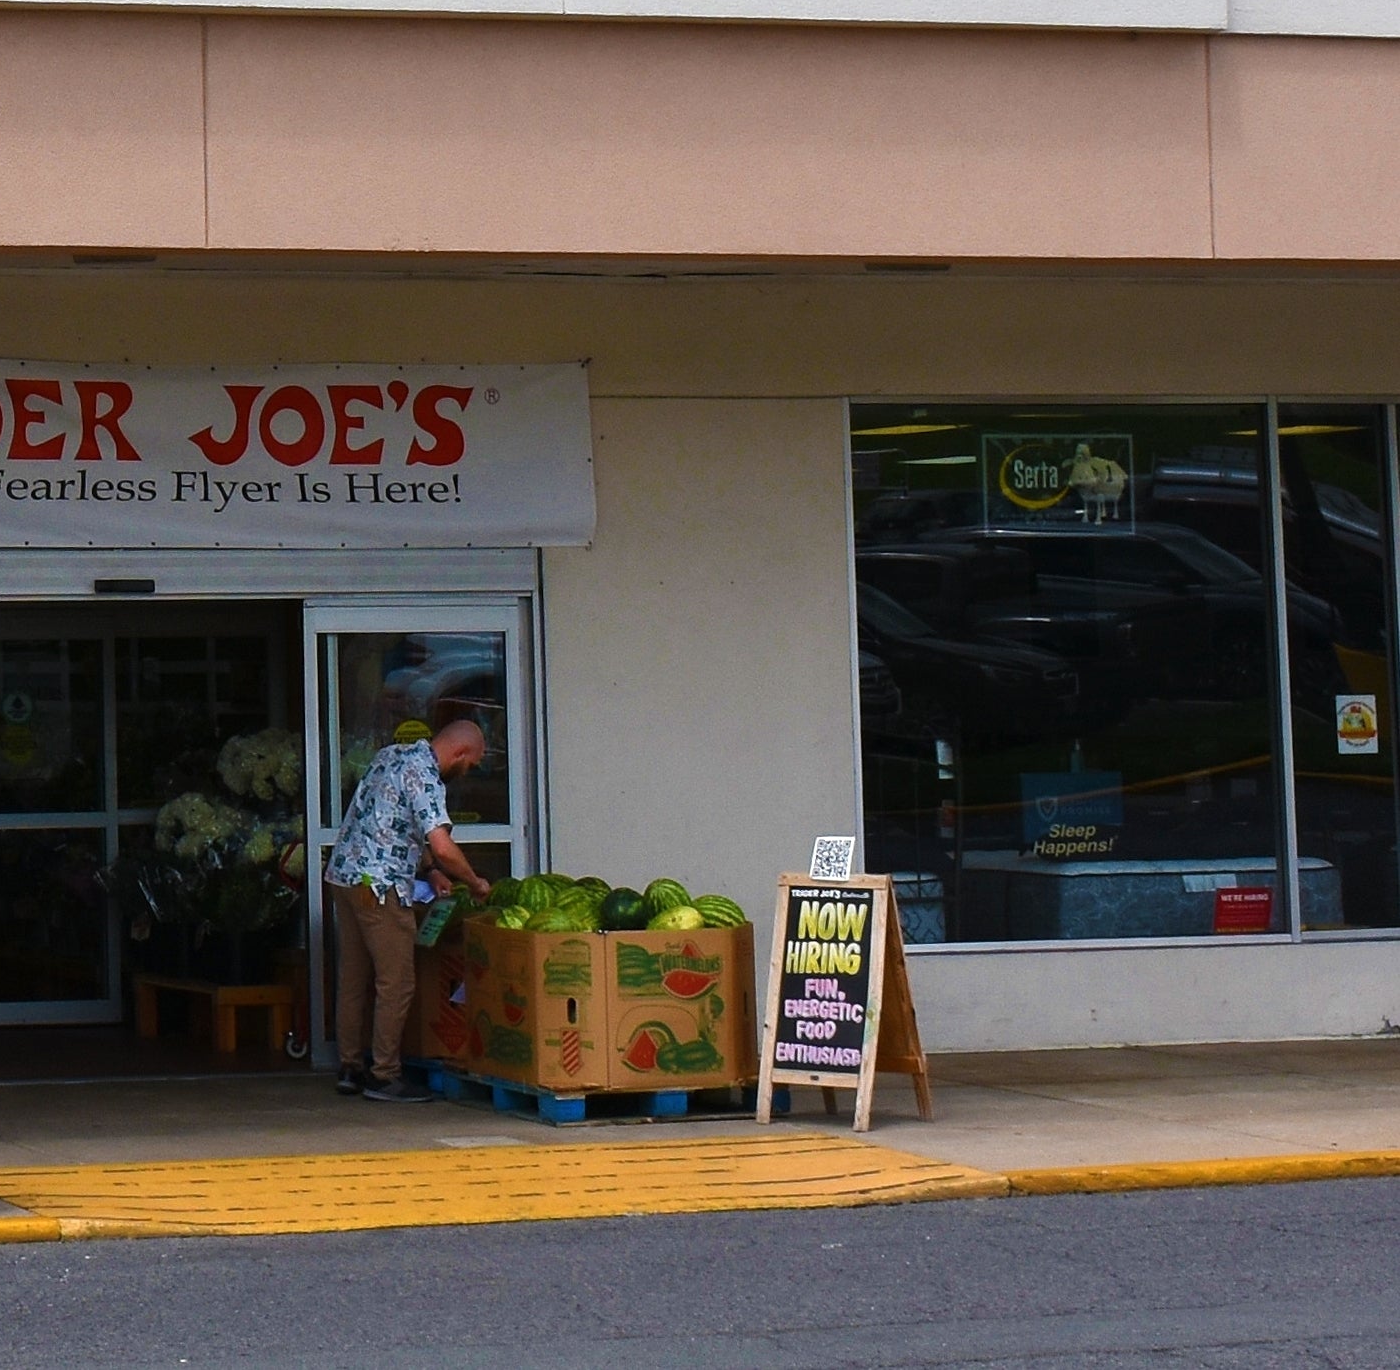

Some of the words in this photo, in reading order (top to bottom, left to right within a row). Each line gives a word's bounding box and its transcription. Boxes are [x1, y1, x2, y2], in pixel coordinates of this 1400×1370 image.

[189, 380, 474, 467] JOE'S
[1013, 459, 1059, 489] Serta
[170, 470, 283, 514] Flyer
[296, 473, 333, 504] Is
[344, 473, 463, 505] Here!
[1048, 824, 1097, 840] Sleep
[1033, 838, 1115, 858] Happens!
[797, 900, 868, 942] NOW
[785, 940, 862, 975] HIRING
[784, 999, 864, 1024] ENERGETIC
[796, 1021, 837, 1040] FOOD
